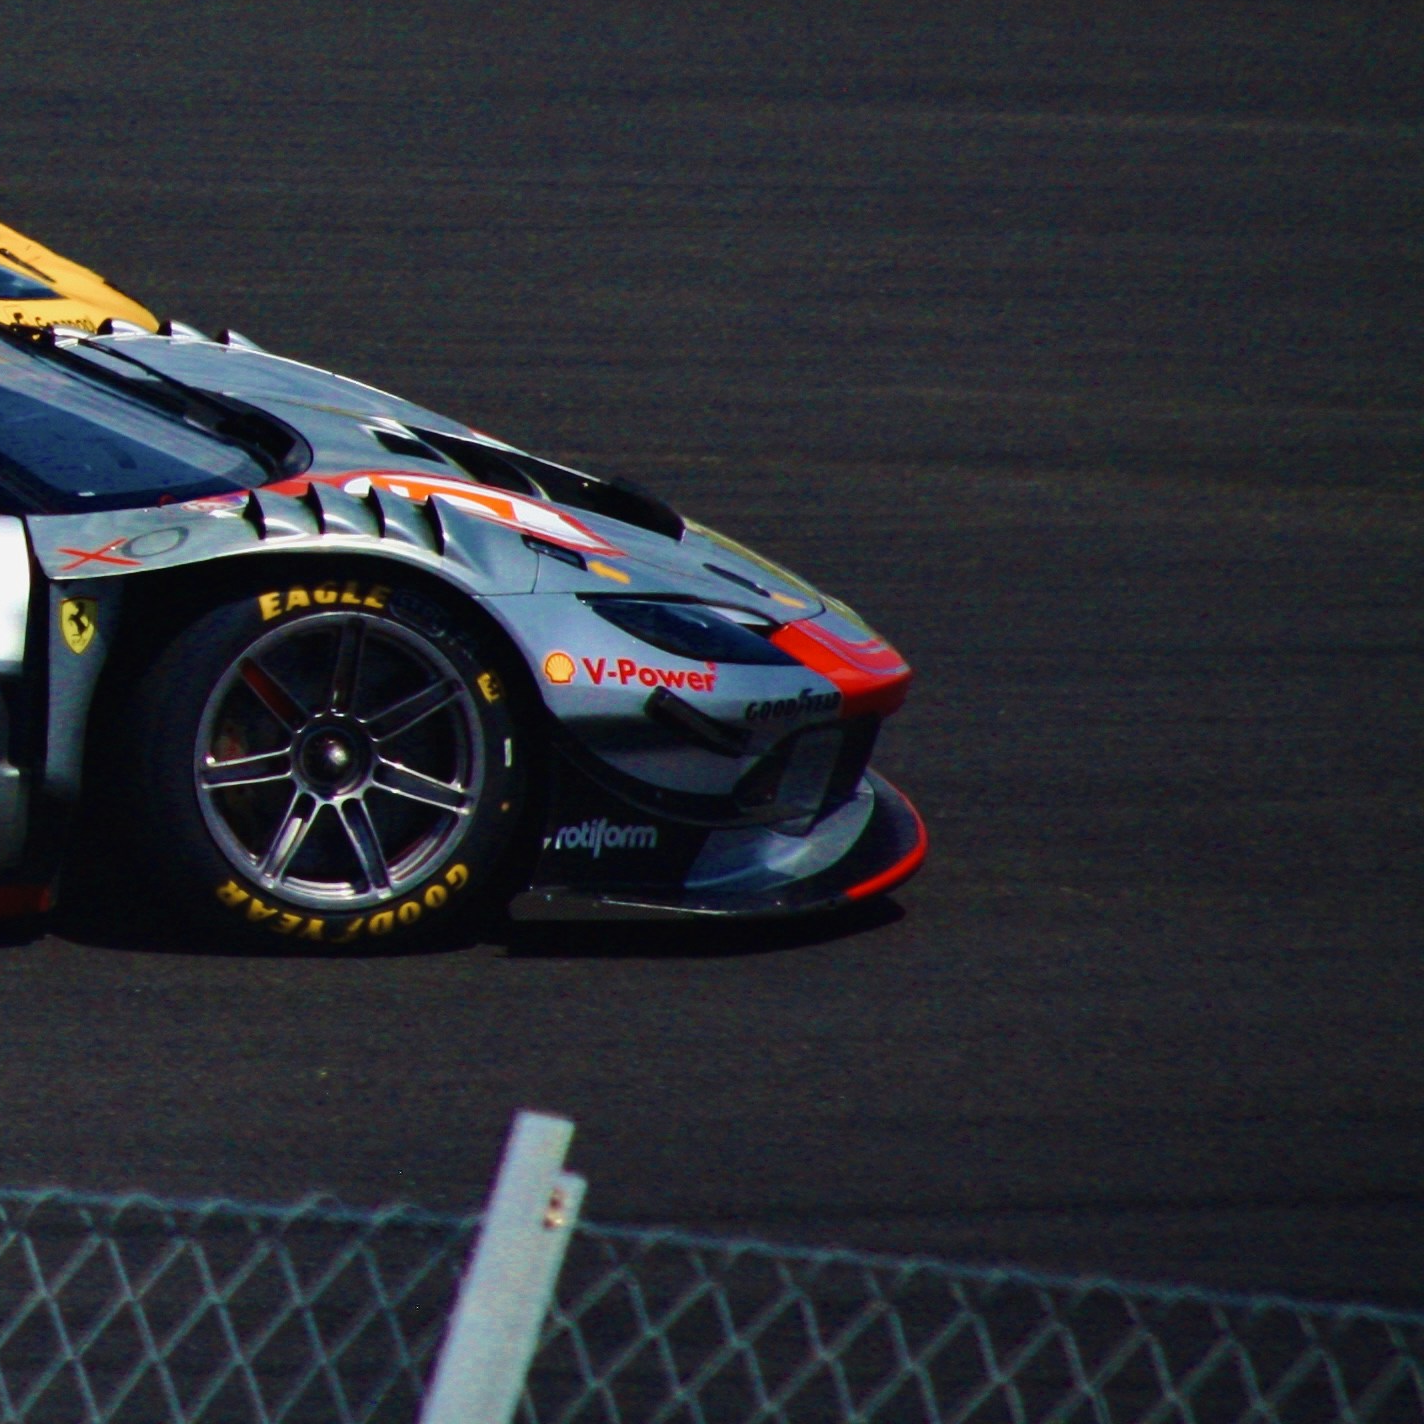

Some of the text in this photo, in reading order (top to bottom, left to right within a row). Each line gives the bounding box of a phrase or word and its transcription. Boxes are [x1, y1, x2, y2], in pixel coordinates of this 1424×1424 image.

[257, 582, 393, 622] EAGLE
[582, 659, 719, 693] V-Power
[555, 817, 658, 859] rotiform
